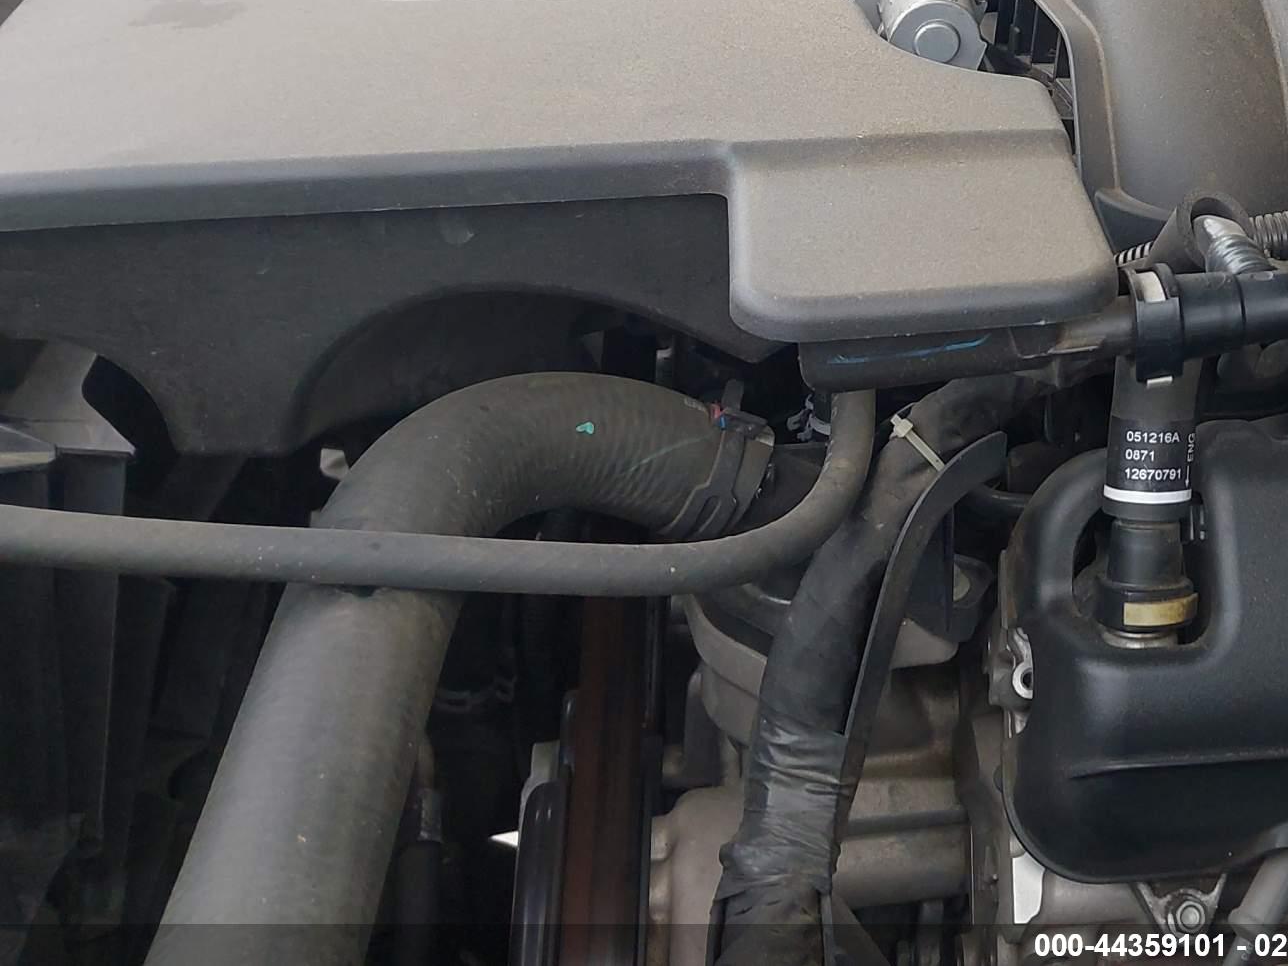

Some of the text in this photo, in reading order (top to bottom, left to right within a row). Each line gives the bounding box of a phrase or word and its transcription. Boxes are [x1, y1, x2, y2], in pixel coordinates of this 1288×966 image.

[1126, 430, 1180, 444] 051216A
[1187, 432, 1196, 463] ENG
[1125, 448, 1155, 462] 0871
[1124, 467, 1182, 481] 12670791
